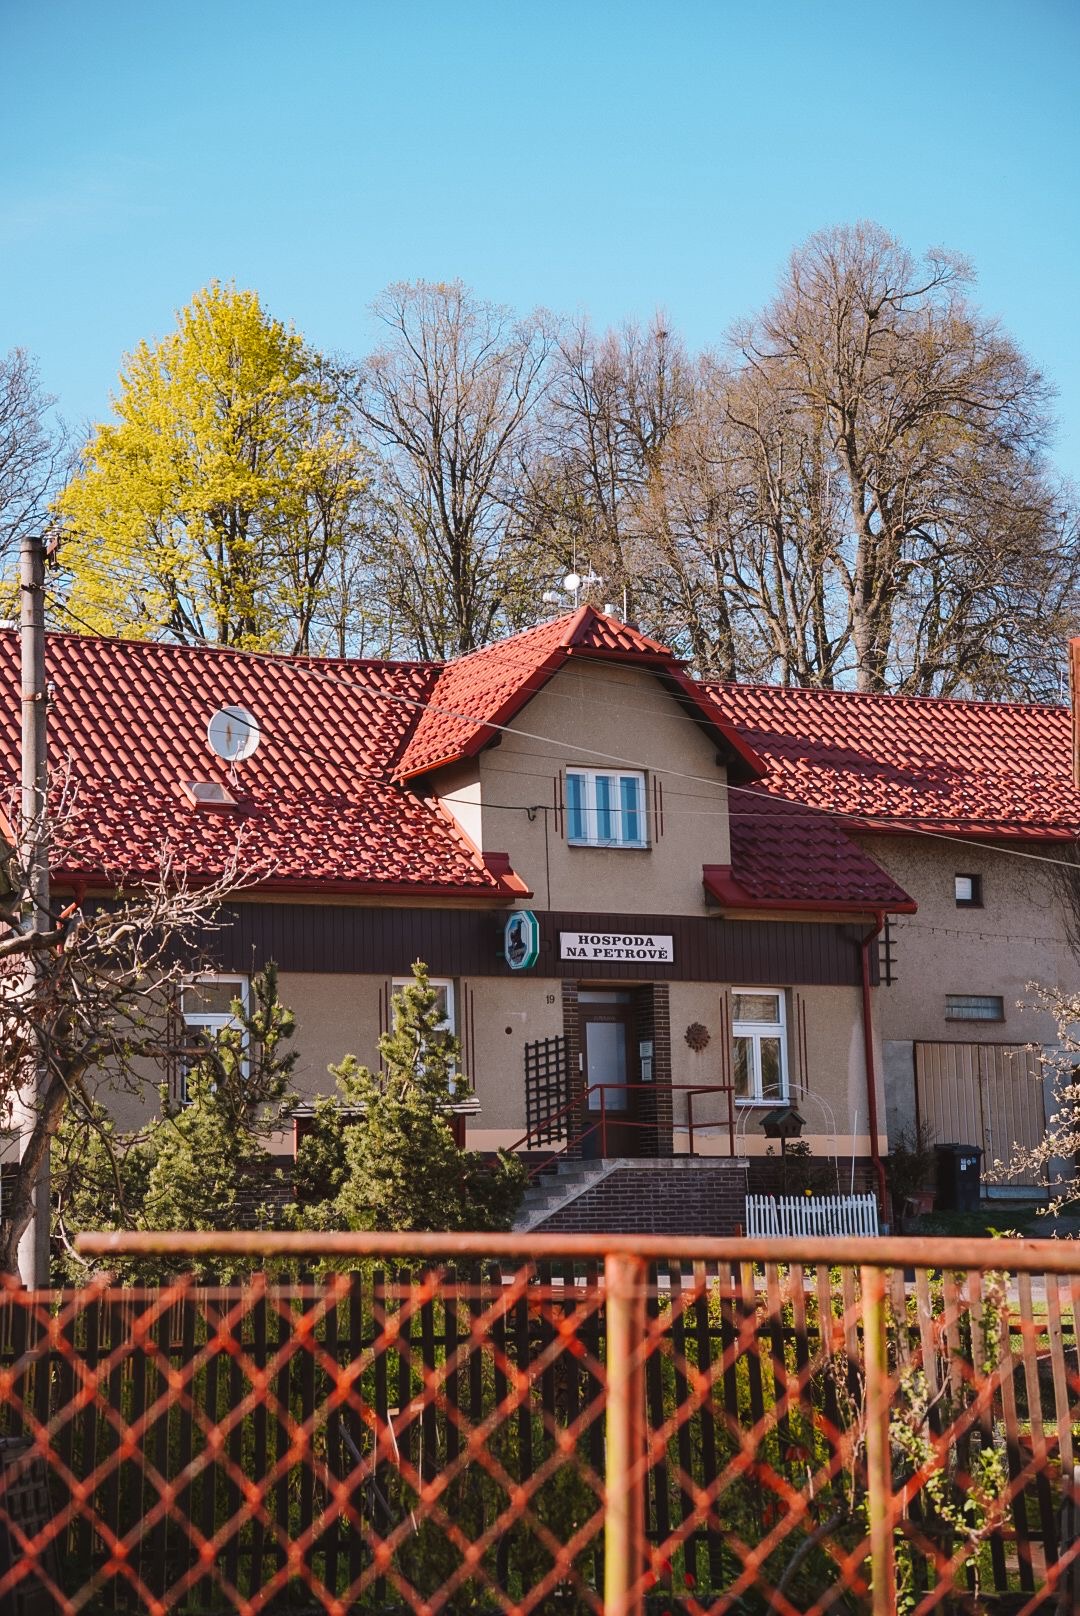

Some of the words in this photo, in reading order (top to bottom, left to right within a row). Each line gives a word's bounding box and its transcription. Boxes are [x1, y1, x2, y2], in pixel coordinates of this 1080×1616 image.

[578, 935, 655, 947] HOSPODA
[566, 947, 588, 957] NA
[592, 947, 668, 959] PETROVĚ
[546, 995, 555, 1004] 19
